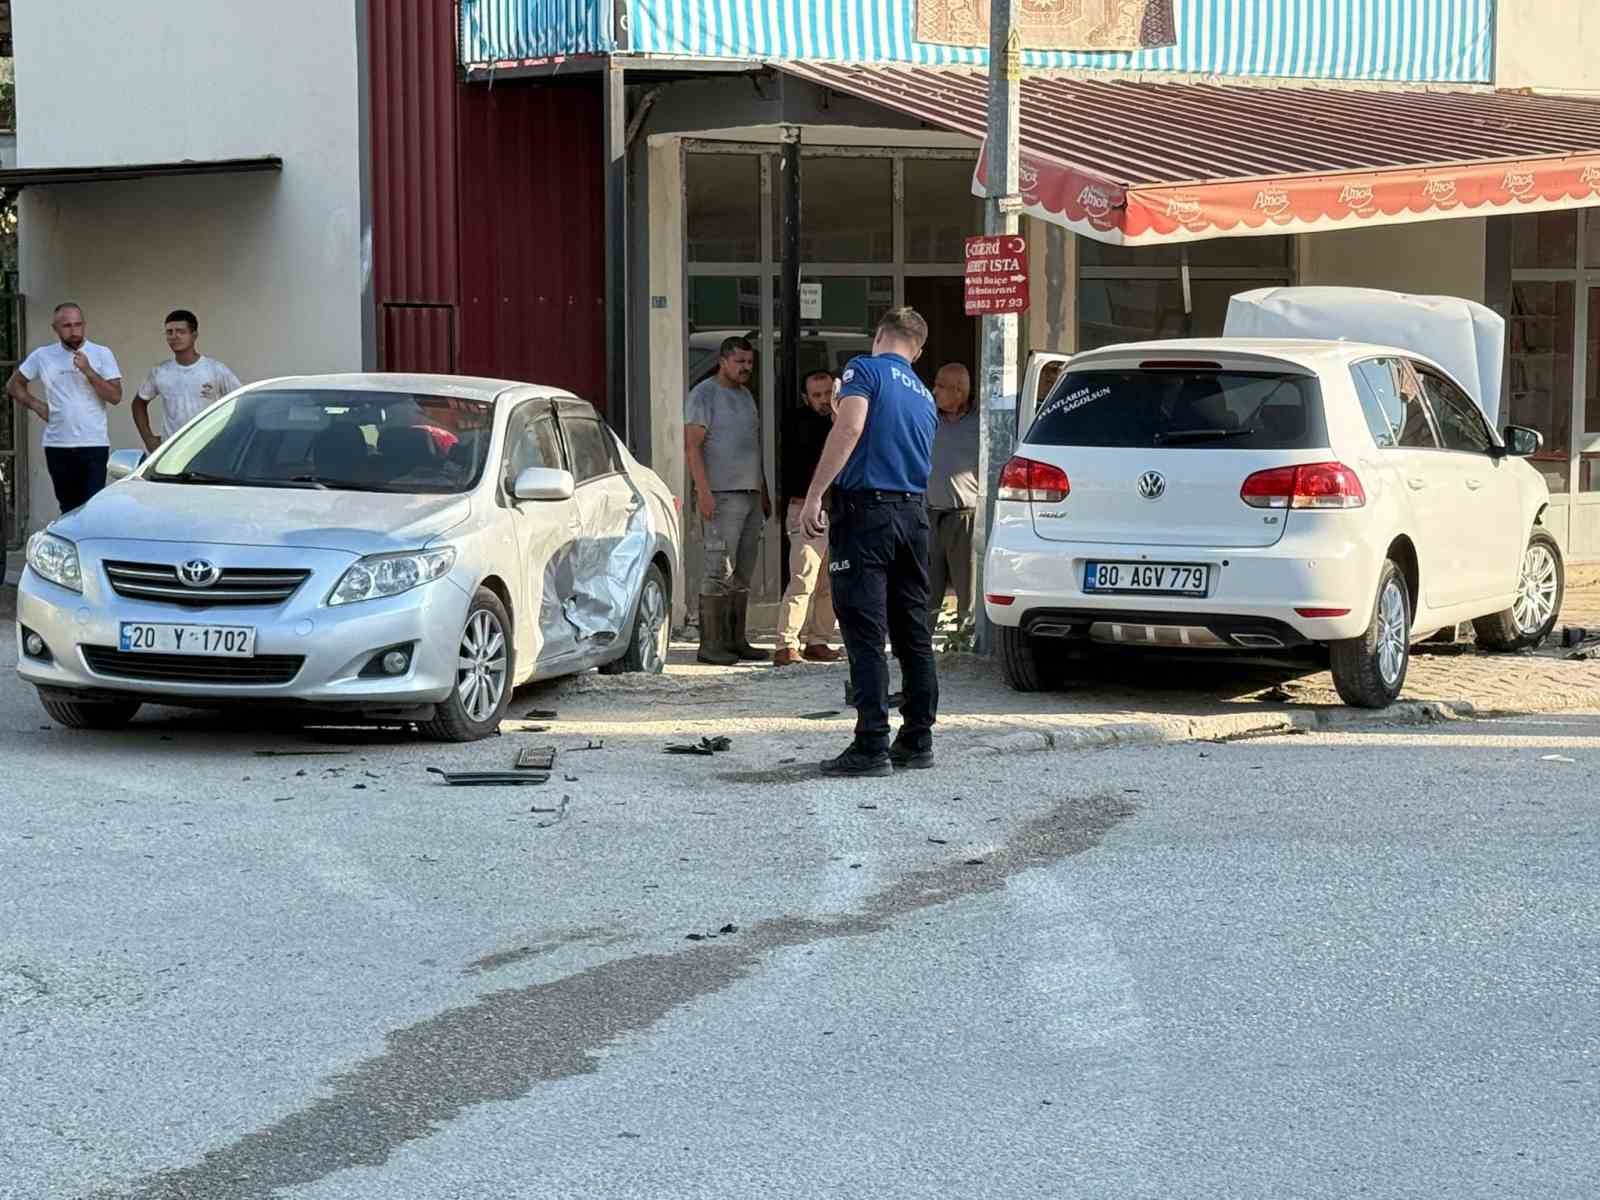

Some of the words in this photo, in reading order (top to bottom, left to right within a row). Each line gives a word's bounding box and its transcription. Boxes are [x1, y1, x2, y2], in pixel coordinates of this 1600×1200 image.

[1098, 566, 1119, 586] 80
[1130, 567, 1165, 587] AGV
[1169, 568, 1203, 589] 779
[132, 626, 155, 648] 20
[174, 628, 185, 650] Y
[202, 629, 248, 652] 1702
